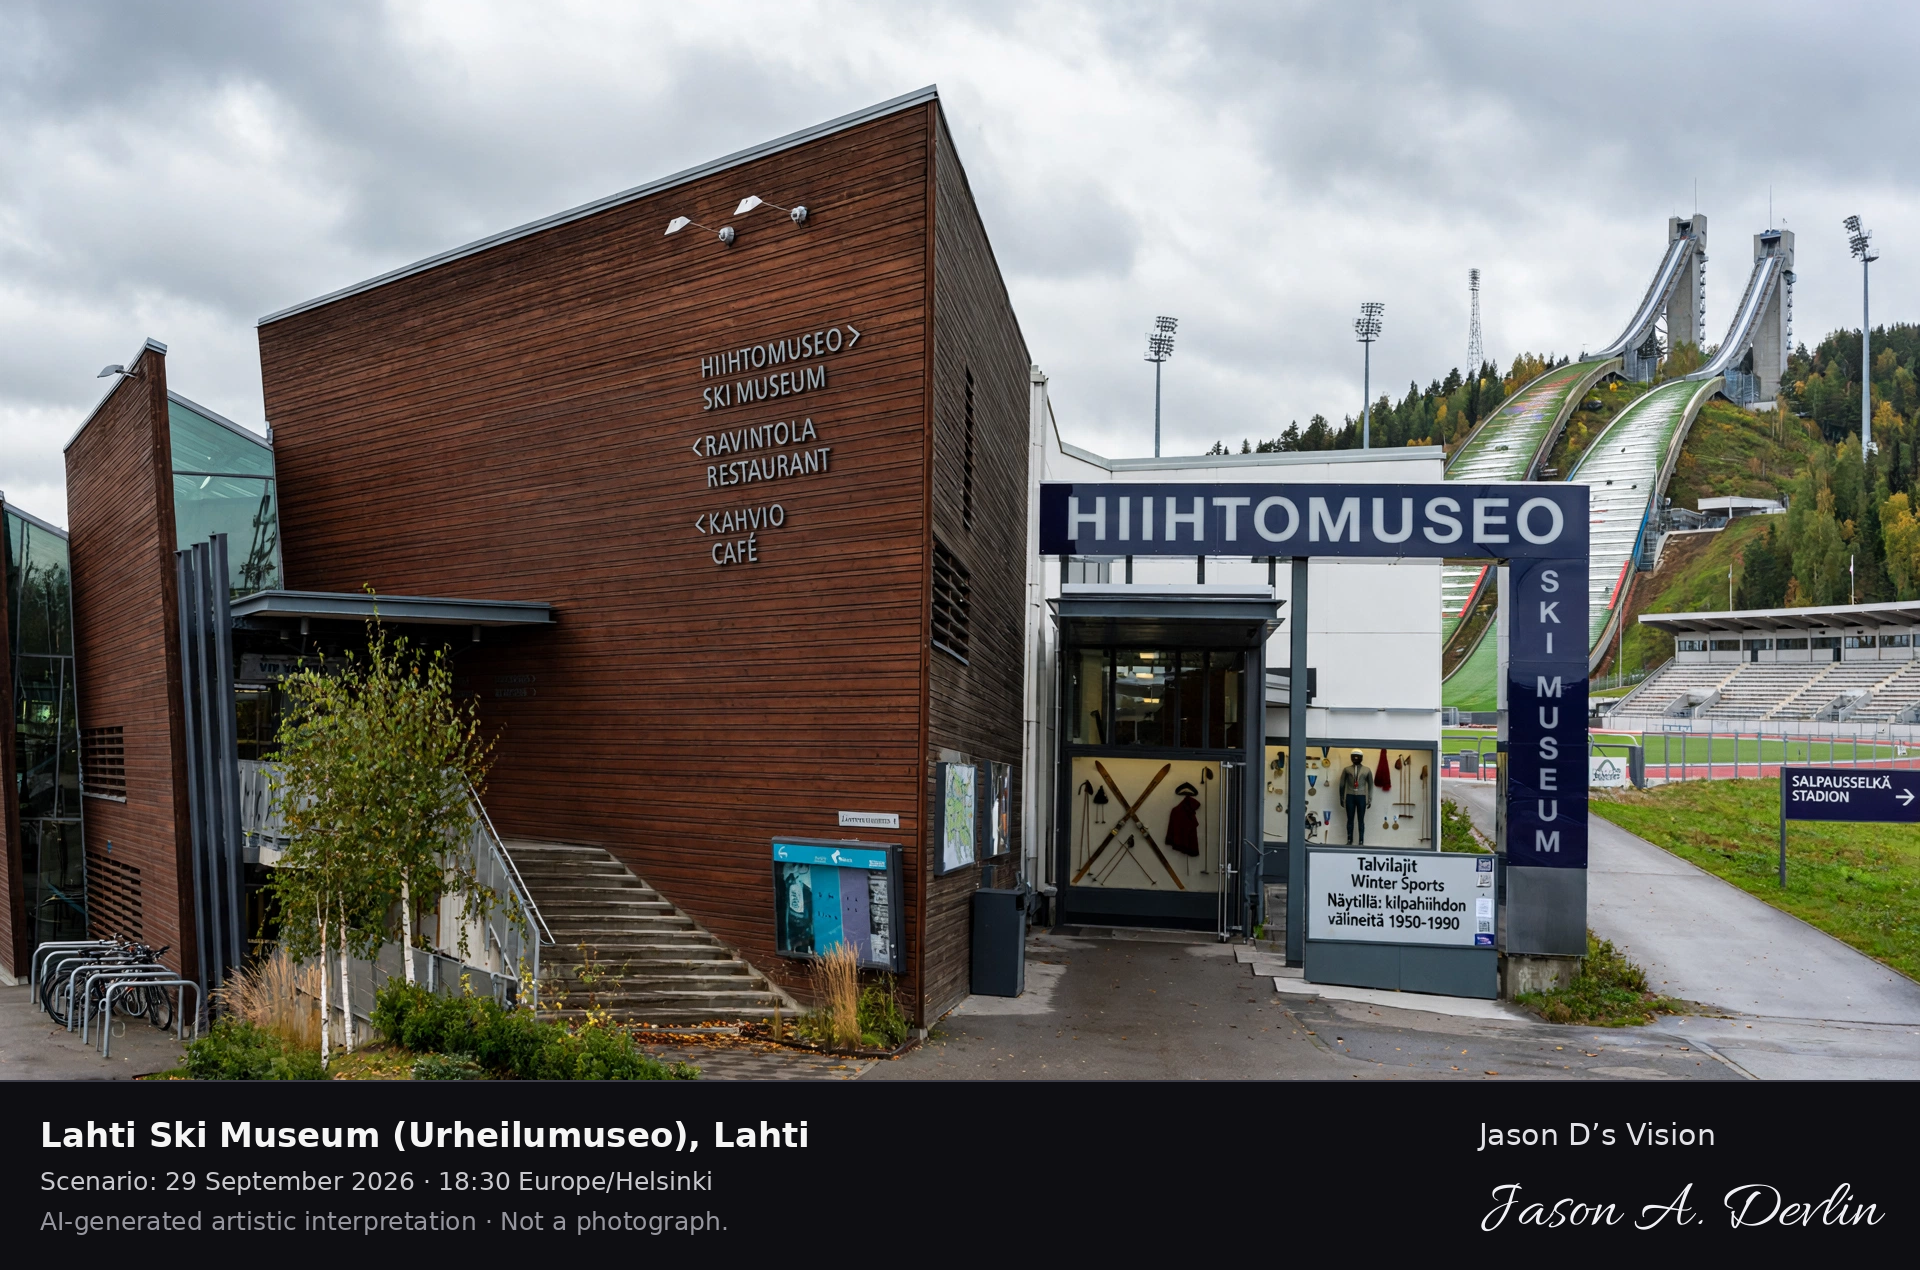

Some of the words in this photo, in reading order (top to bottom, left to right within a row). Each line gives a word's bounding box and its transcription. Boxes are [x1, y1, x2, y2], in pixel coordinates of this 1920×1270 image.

[701, 328, 842, 378] HIIHTOMUSEO
[703, 384, 731, 410] SKI
[737, 365, 826, 404] MUSEUM
[705, 418, 817, 456] RAVINTOLA
[707, 448, 831, 488] RESTAURANT
[709, 504, 785, 534] KAHVIO
[1068, 496, 1565, 545] HIIHTOMUSEO
[711, 532, 758, 565] CAFÉ
[1539, 569, 1561, 654] SKI
[1535, 675, 1562, 853] MUSEUM
[1792, 775, 1892, 790] SALPAUSSELKÄ
[1792, 790, 1850, 804] STADION
[1357, 857, 1418, 876] Talvilajit
[1351, 874, 1397, 890] Winter
[1401, 877, 1445, 894] Sports
[1327, 892, 1382, 911] Näytillä:
[1386, 895, 1466, 913] kilpahiihdon
[1328, 912, 1384, 928] välineitä
[1389, 914, 1460, 930] 1950-1990
